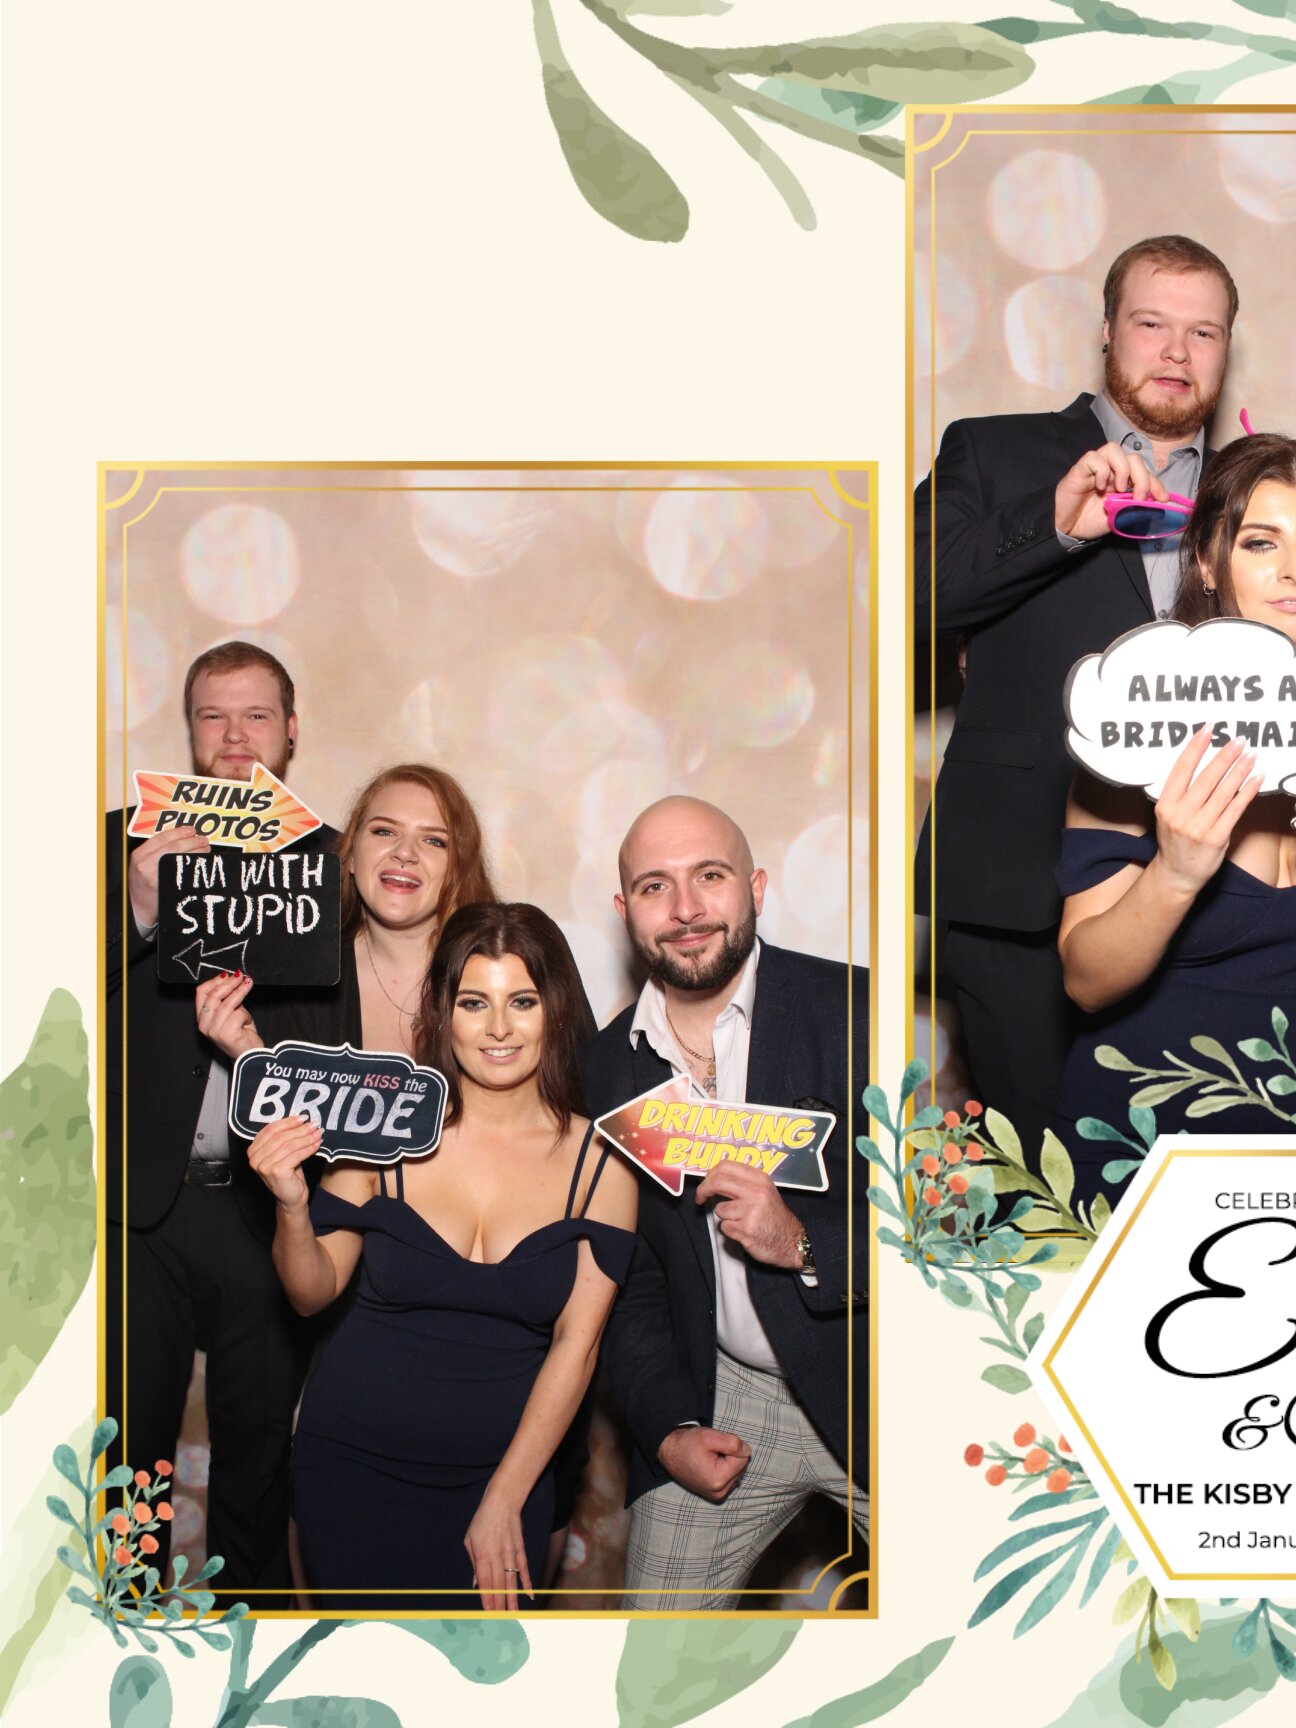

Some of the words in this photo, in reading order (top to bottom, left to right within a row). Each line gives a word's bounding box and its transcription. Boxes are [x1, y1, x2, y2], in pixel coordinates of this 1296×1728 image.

[1128, 674, 1264, 702] ALWAYS
[171, 780, 274, 812] RUINS
[154, 810, 281, 842] PHOTOS
[175, 854, 227, 890] I'M
[265, 1062, 291, 1077] You
[296, 1067, 328, 1082] may
[329, 1072, 361, 1086] now
[363, 1073, 401, 1090] KISS
[404, 1078, 428, 1093] the
[248, 1076, 427, 1139] BRIDE
[637, 1099, 817, 1149] DRINKING
